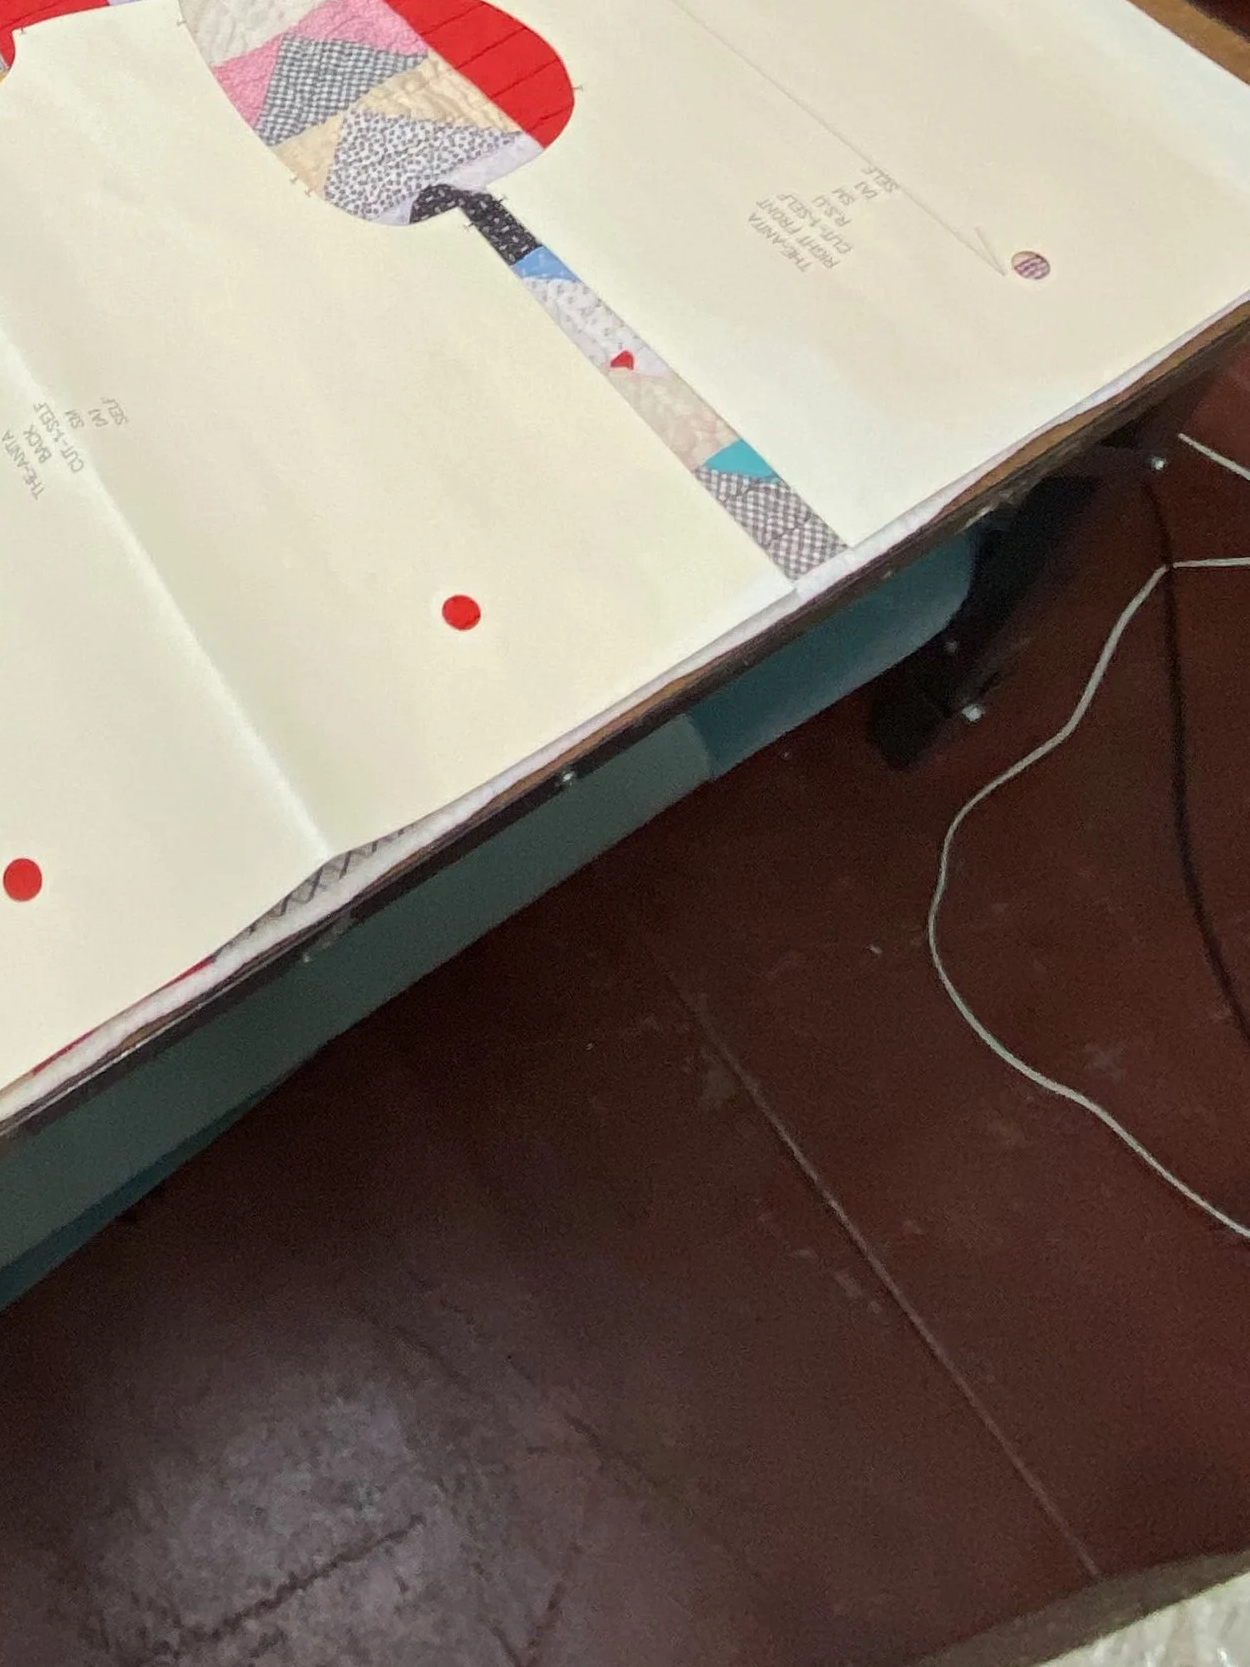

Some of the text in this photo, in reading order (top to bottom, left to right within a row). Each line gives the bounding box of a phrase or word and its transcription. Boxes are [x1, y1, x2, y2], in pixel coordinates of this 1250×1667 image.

[861, 165, 900, 194] SELF
[756, 198, 840, 270] RIGHT FRONT
[101, 397, 129, 426] SELF
[23, 424, 52, 464] BACK
